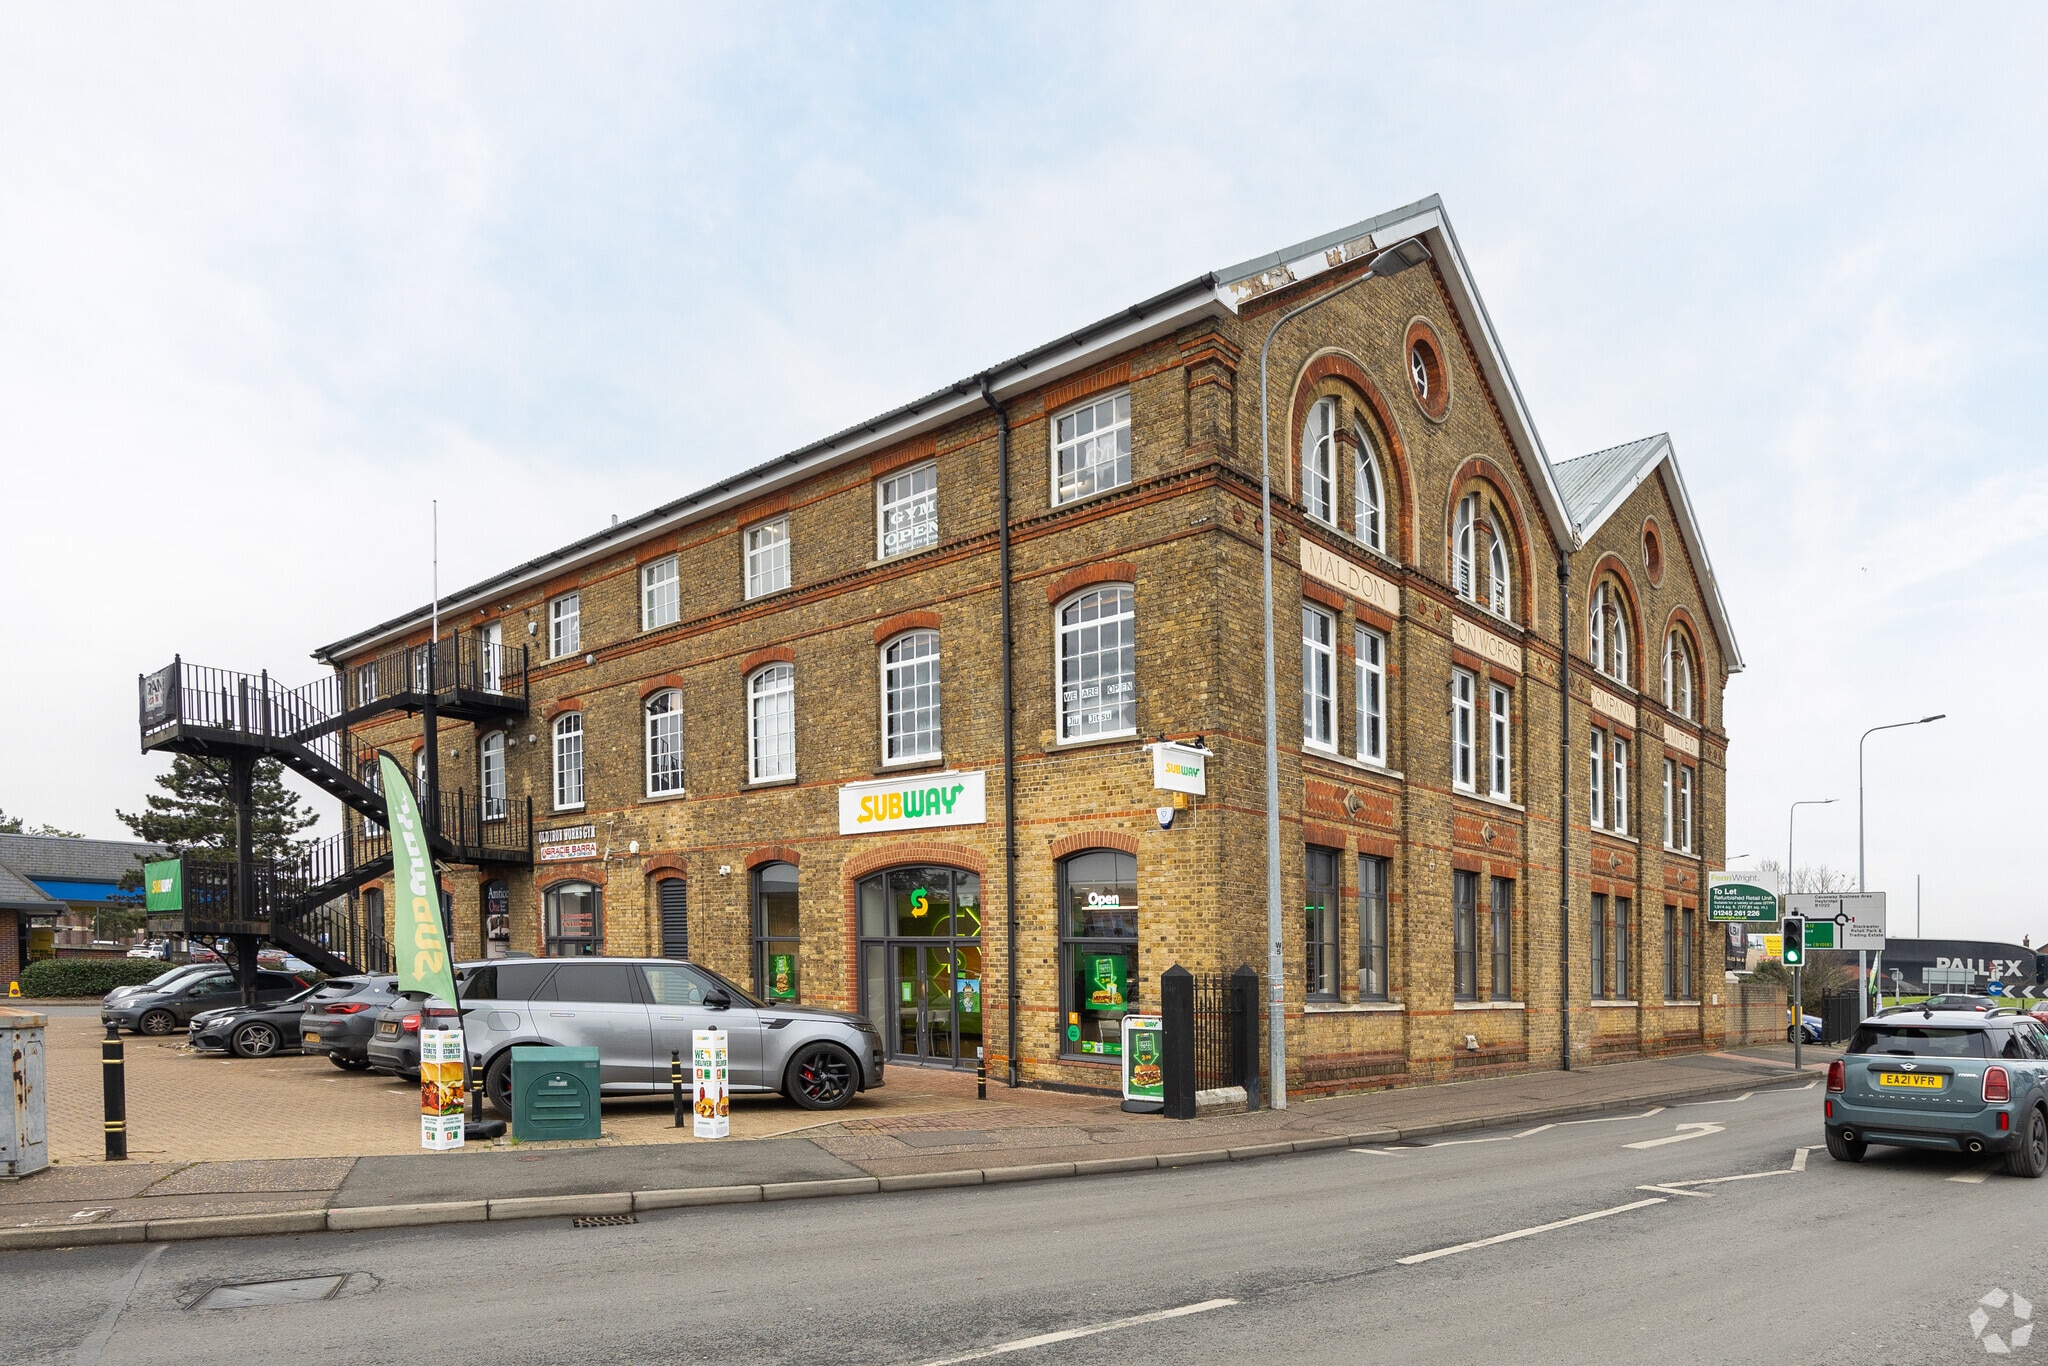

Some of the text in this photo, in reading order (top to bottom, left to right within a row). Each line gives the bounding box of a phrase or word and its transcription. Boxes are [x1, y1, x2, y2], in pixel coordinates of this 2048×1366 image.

[890, 499, 936, 525] GYM
[885, 520, 939, 546] OPEN
[1309, 546, 1386, 605] MALDON
[1452, 618, 1520, 667] RON WORKS
[1064, 682, 1132, 701] WE ARE OPEN
[1068, 712, 1111, 725] Jiu Jitsu
[1165, 762, 1200, 777] SUBWAY
[857, 783, 965, 825] SUBWAY
[583, 825, 596, 839] GYM
[545, 843, 596, 855] GRACIE BARRA
[152, 878, 173, 893] SUBWAY
[1088, 891, 1120, 908] Open
[694, 1049, 705, 1060] WE
[715, 1049, 722, 1060] WE
[694, 1059, 712, 1067] DELIVER
[715, 1059, 727, 1067] DELIVER
[1886, 1074, 1935, 1086] EA21 VFR
